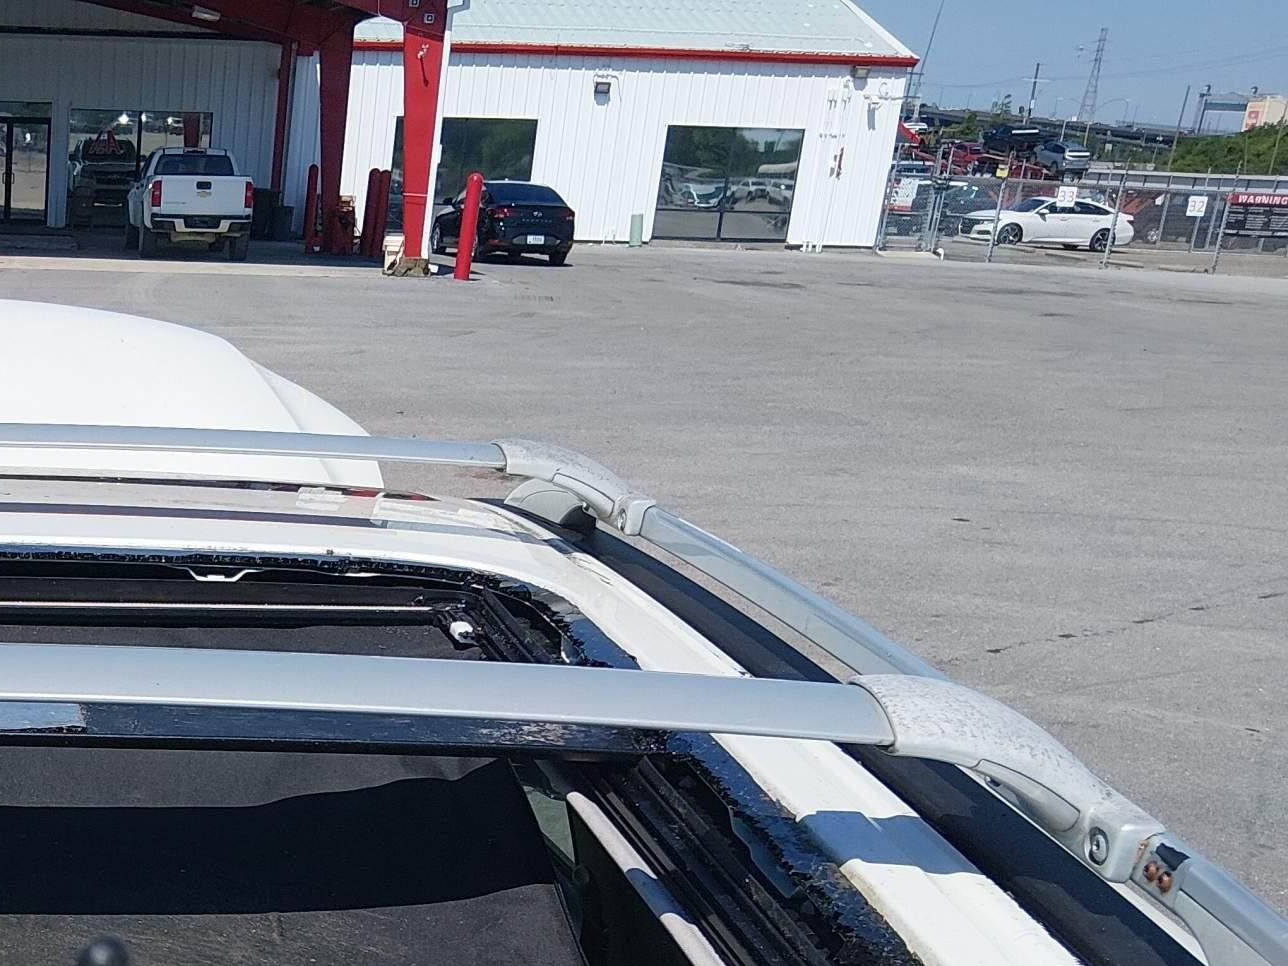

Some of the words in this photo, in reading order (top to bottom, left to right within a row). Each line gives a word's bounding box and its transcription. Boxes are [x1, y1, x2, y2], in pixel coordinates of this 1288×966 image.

[1059, 190, 1075, 203] 33
[1238, 194, 1288, 205] WARNING
[1189, 200, 1205, 213] 32
